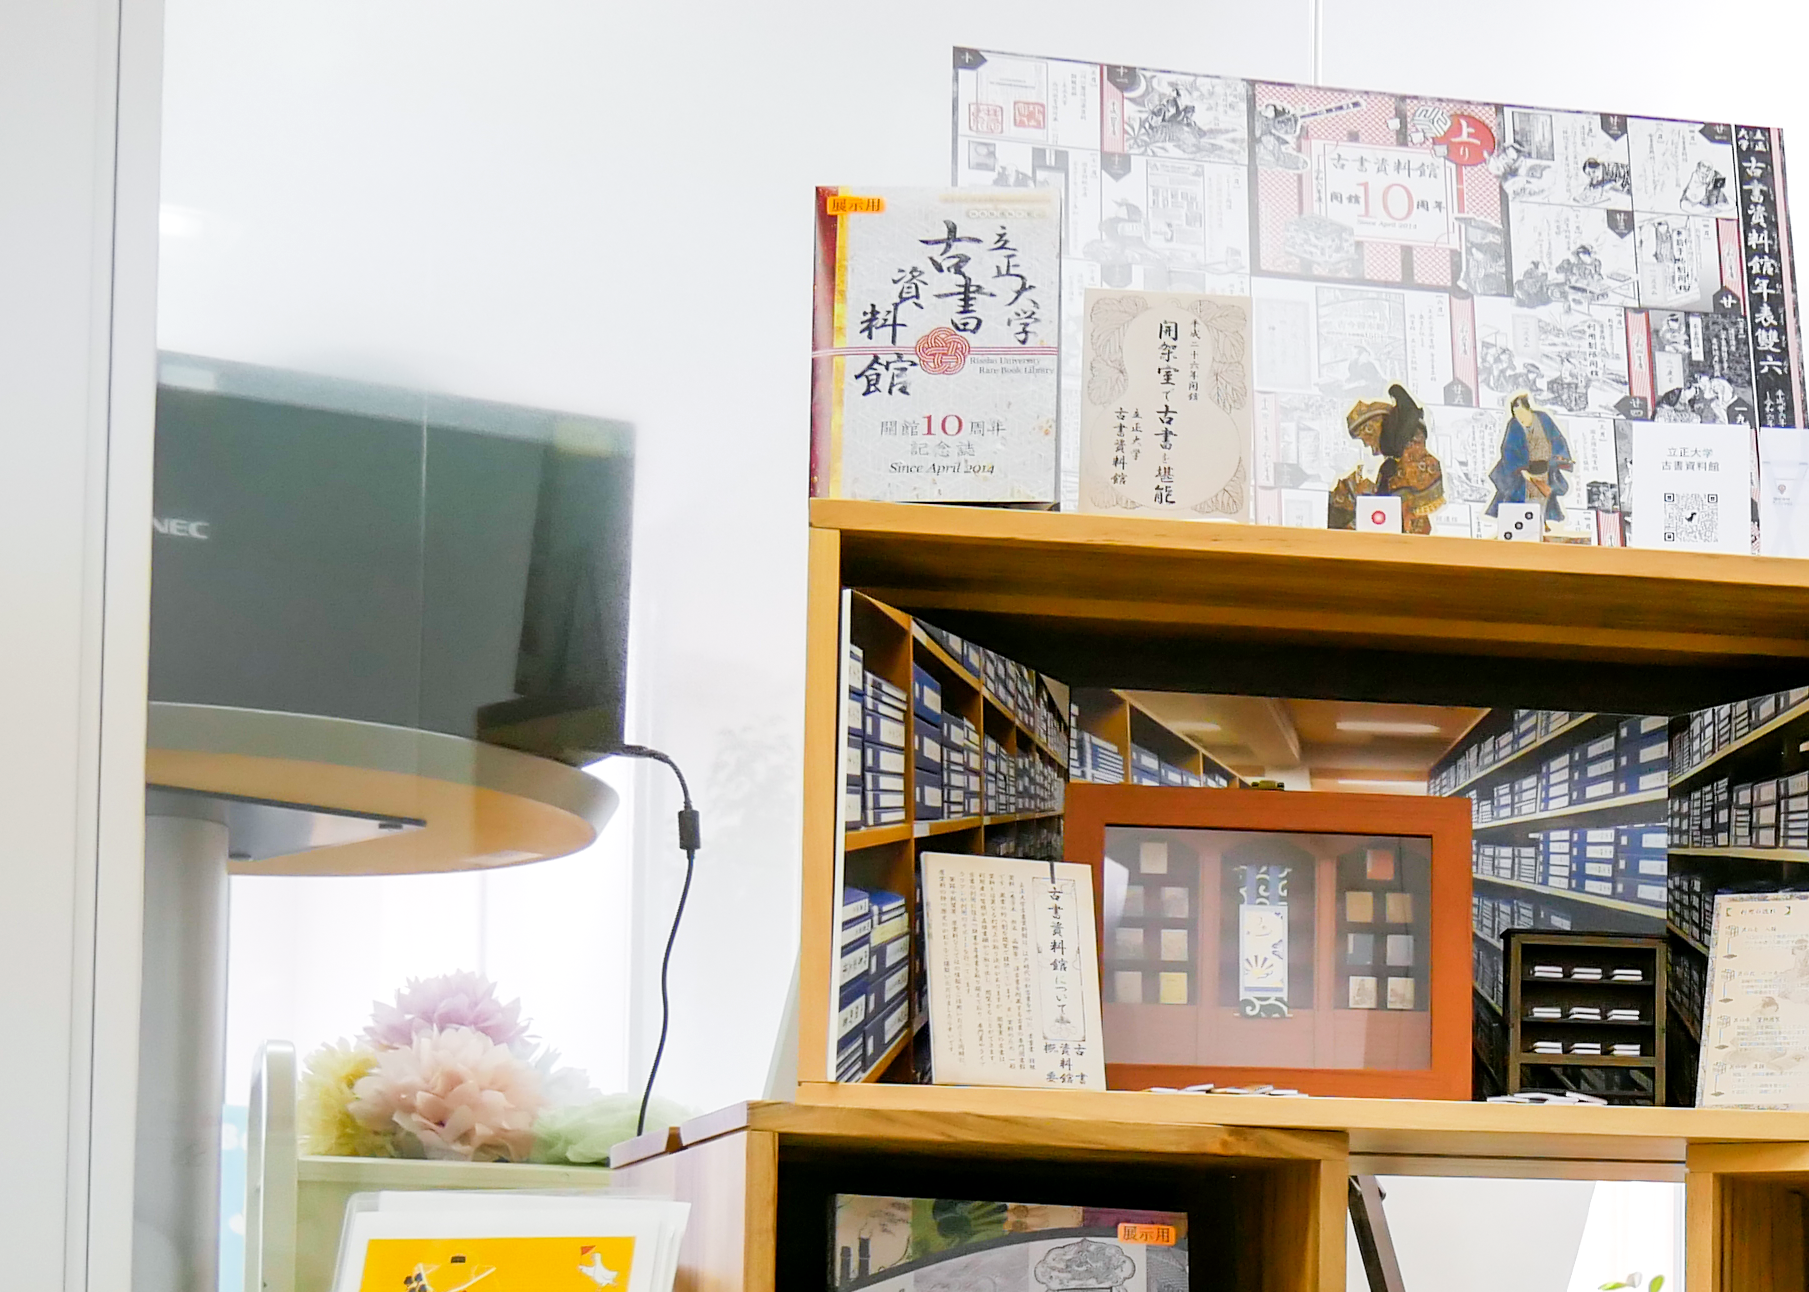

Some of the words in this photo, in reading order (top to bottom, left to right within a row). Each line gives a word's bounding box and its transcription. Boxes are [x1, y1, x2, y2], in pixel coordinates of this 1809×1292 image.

[1330, 153, 1439, 180] 古書資料館
[831, 196, 882, 212] 展示用
[918, 219, 996, 335] 古書
[988, 225, 1040, 345] 立正大学
[854, 266, 929, 397] 資料館
[1111, 406, 1127, 486] 古書資料館
[1129, 407, 1143, 461] 立正大学
[910, 440, 977, 457] 記念誌
[1667, 447, 1713, 458] 立正大学
[889, 461, 923, 475] Since
[928, 461, 961, 478] April
[964, 463, 995, 476] 2014
[1661, 460, 1720, 473] 古書資料館
[152, 517, 211, 541] NEC
[1123, 1225, 1171, 1243] 展示用
